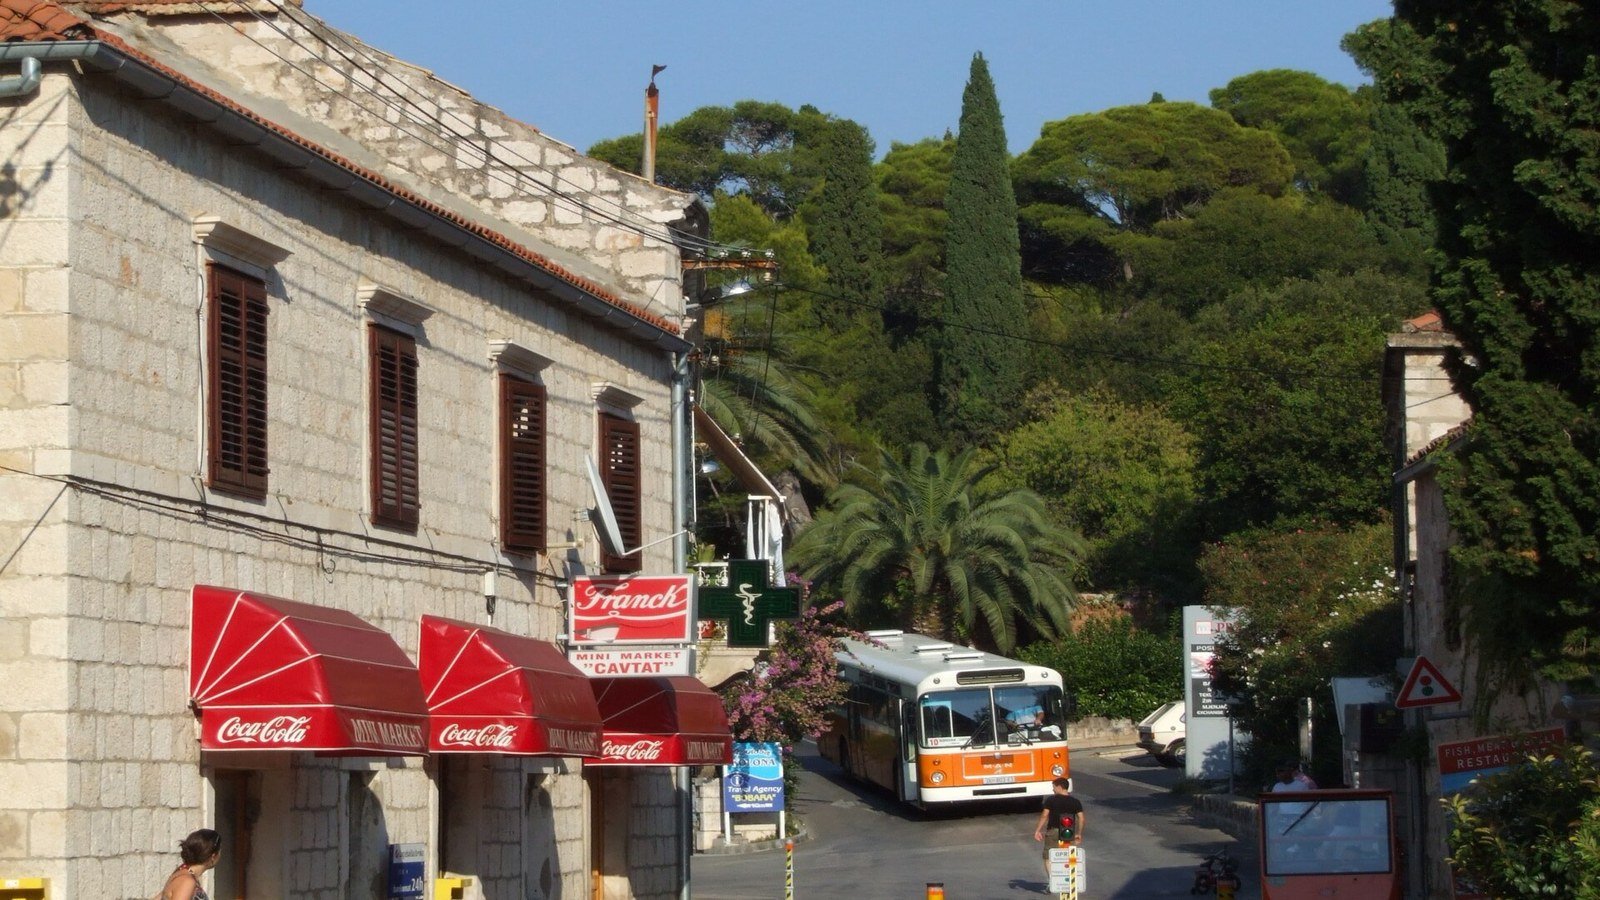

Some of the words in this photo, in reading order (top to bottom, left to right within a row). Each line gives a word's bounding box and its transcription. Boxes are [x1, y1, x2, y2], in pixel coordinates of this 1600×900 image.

[577, 582, 688, 610] Franck
[576, 653, 610, 661] MINI
[620, 652, 681, 660] MARKET
[216, 716, 313, 744] Coca-Cola
[378, 721, 425, 748] MARKET
[439, 723, 519, 747] Coca-Cola
[930, 738, 939, 746] 10
[600, 740, 664, 761] Coca-Cola
